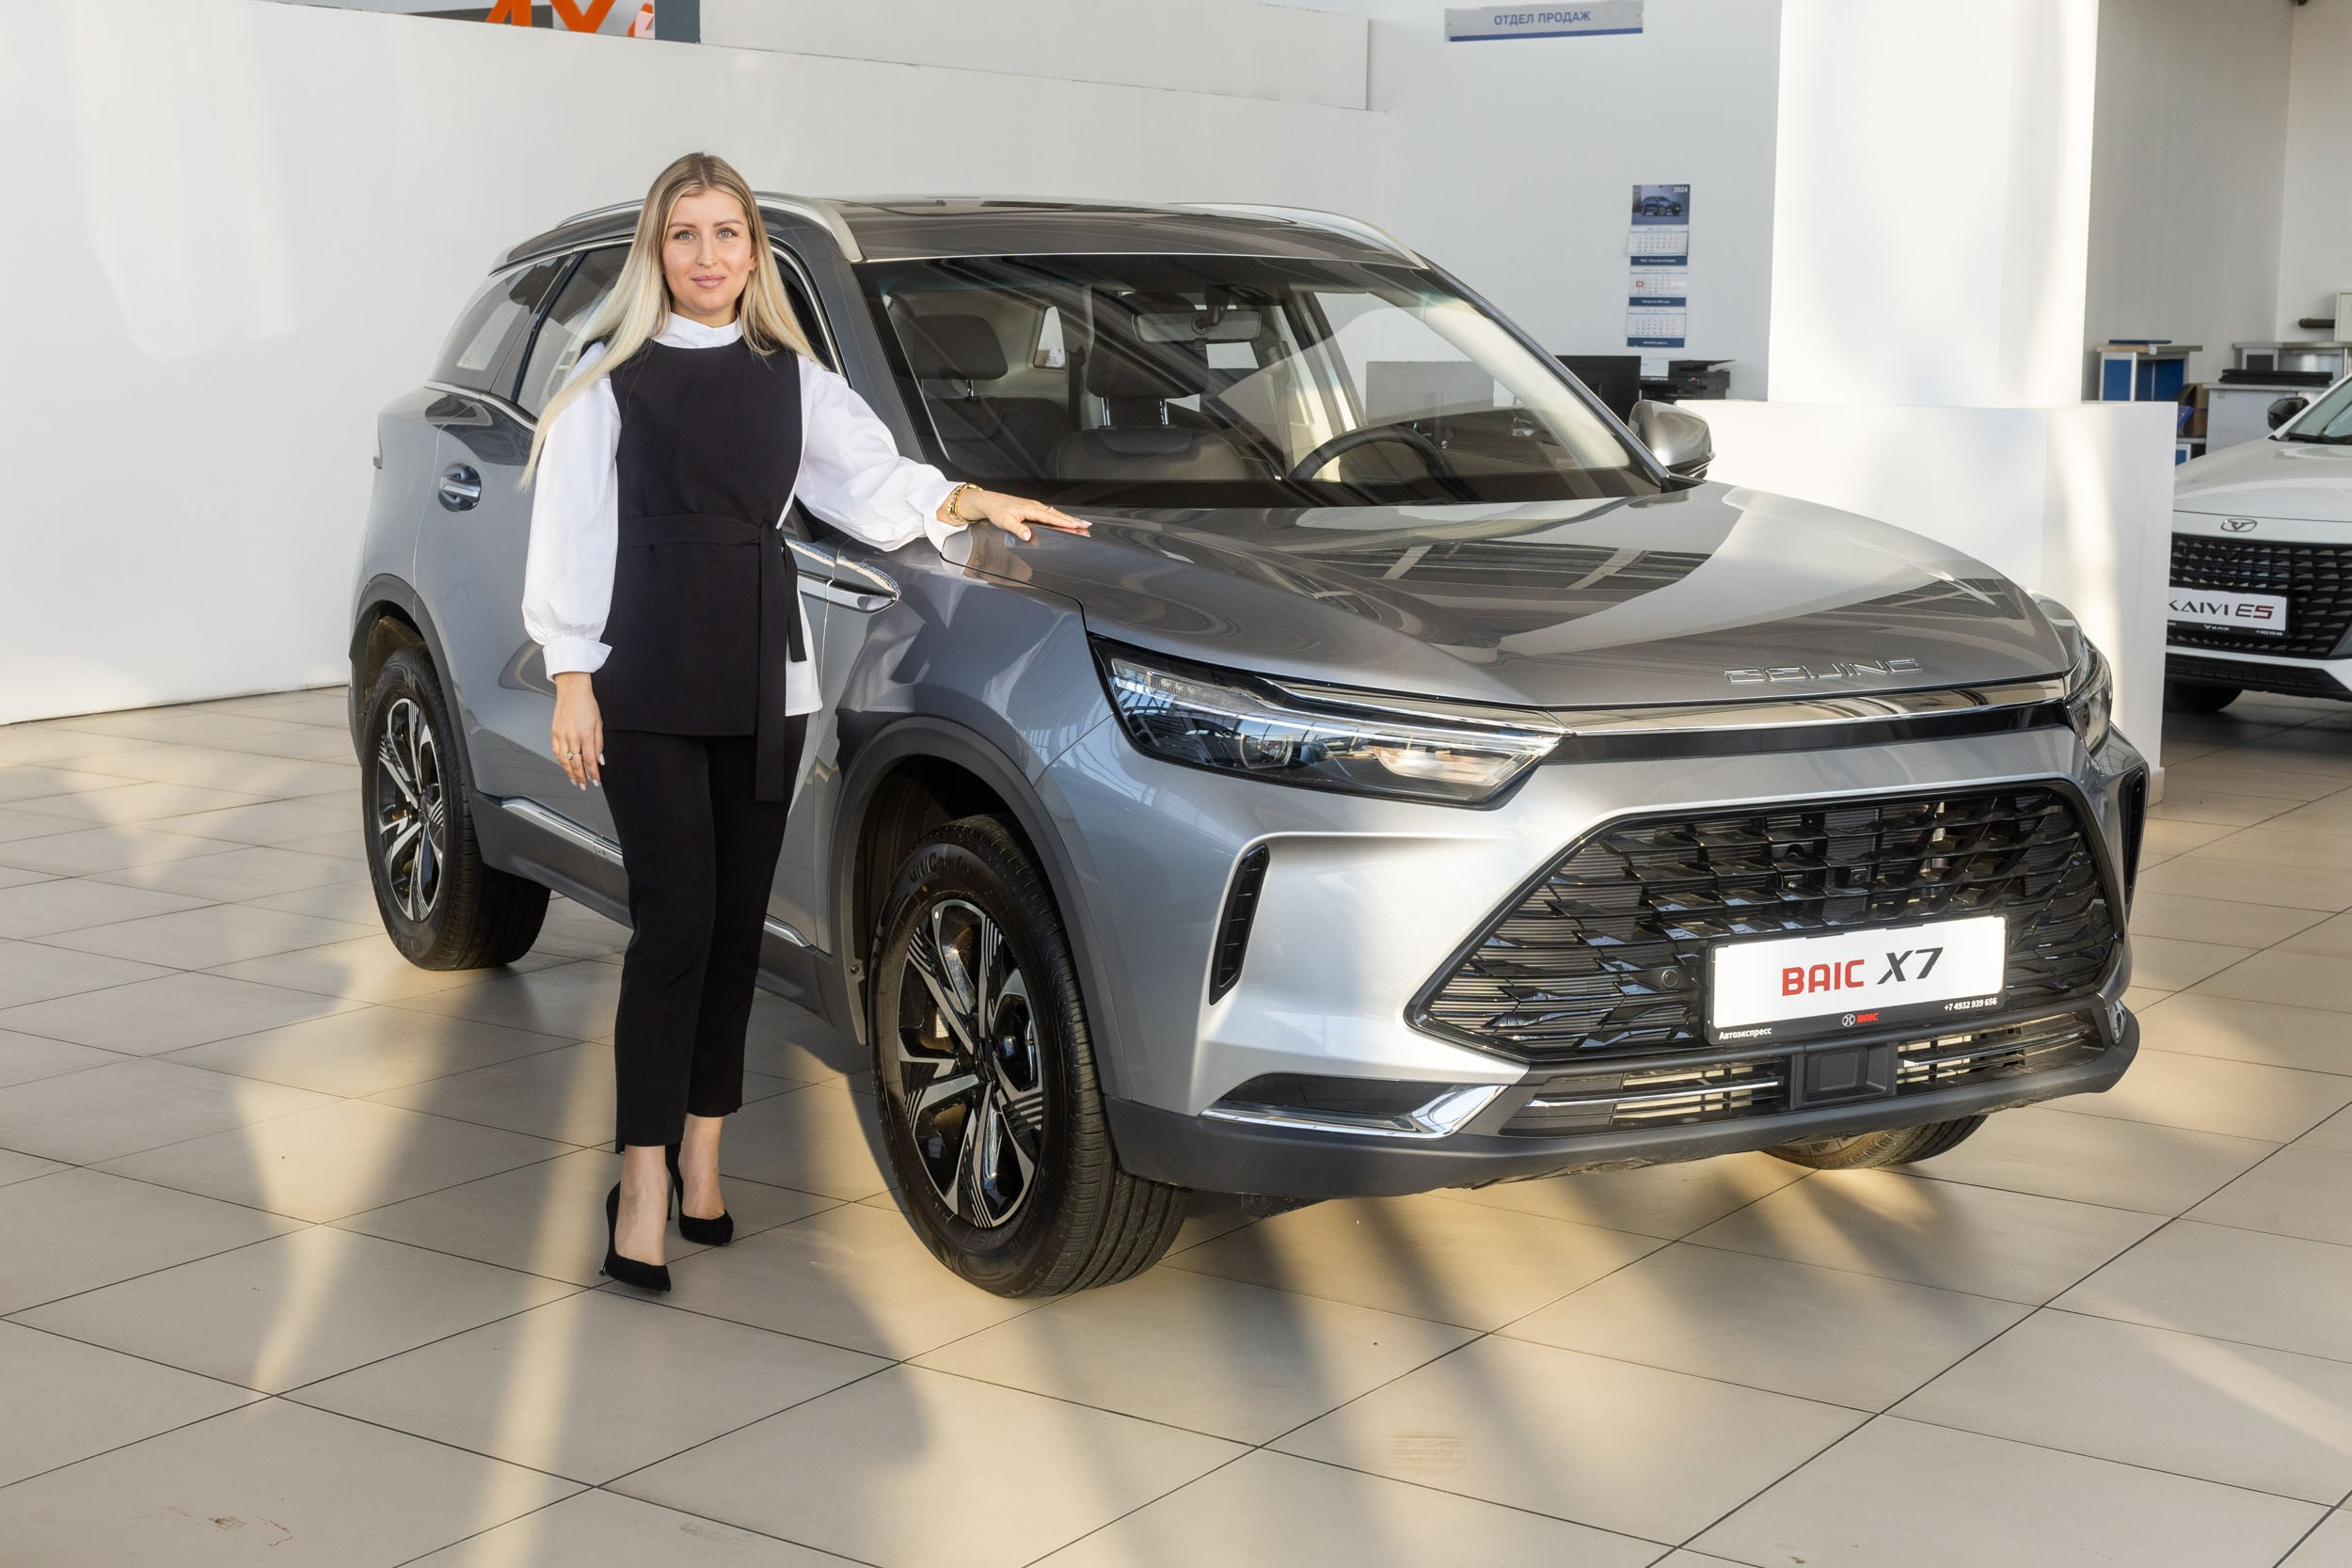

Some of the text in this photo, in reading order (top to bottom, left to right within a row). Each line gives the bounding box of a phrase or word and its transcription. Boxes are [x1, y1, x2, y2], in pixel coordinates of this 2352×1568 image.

[1494, 10, 1591, 26] ОТДЕЛ ПРОДАЖ
[1724, 657, 1923, 684] BEIJING
[1782, 946, 1944, 996] BAIC X7
[1944, 996, 1997, 1011] +7 4932 939 656
[1856, 1012, 1879, 1023] BAIC
[1718, 1027, 1772, 1040] Автоэкспресс
